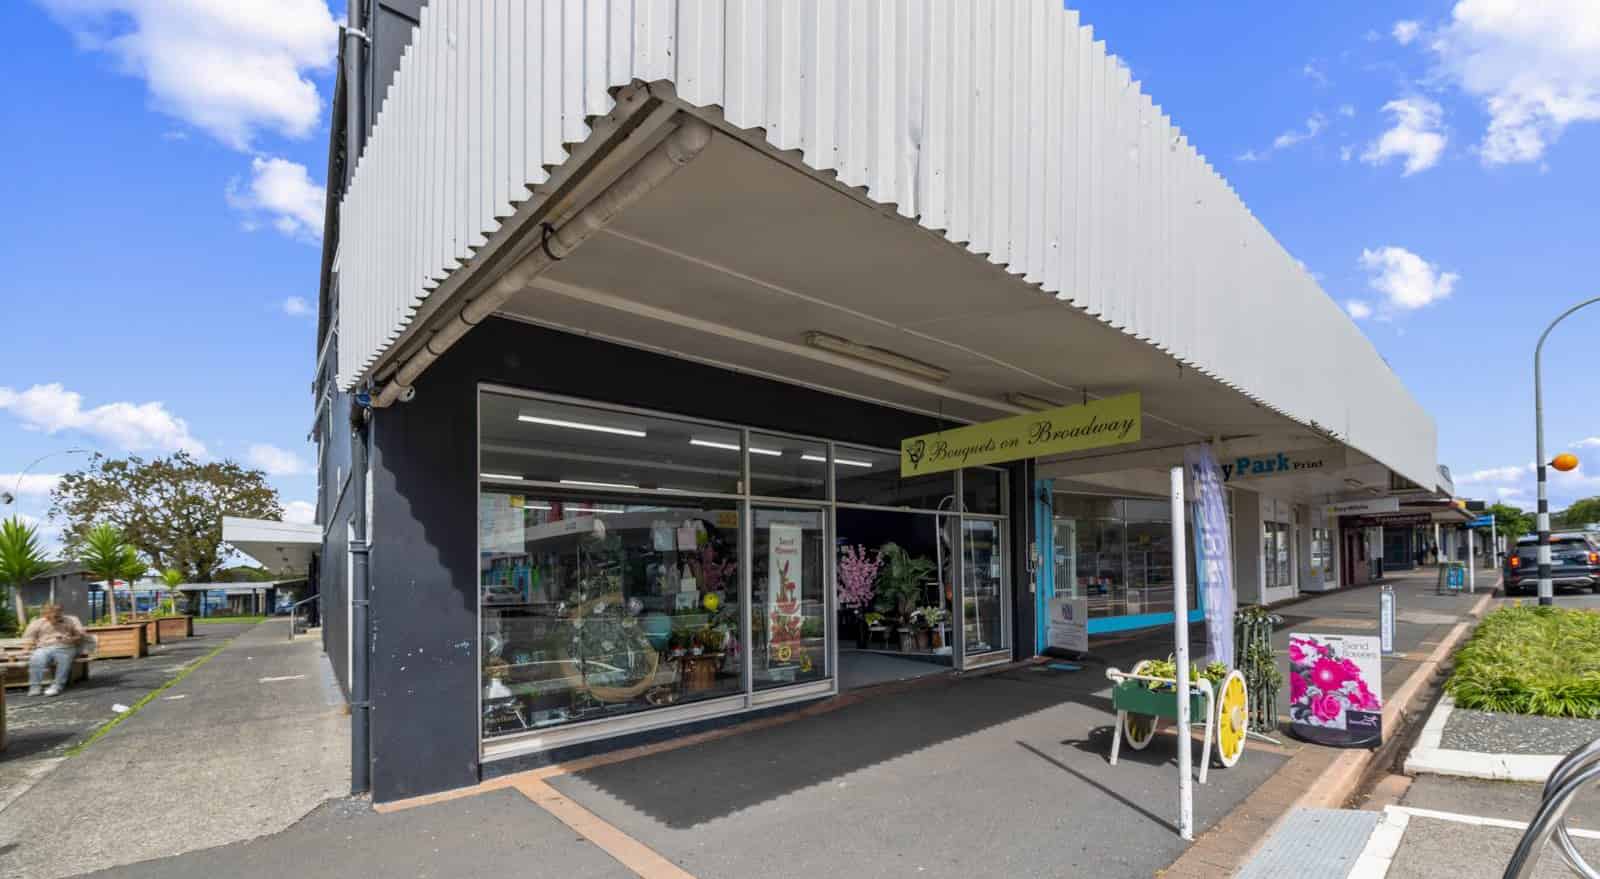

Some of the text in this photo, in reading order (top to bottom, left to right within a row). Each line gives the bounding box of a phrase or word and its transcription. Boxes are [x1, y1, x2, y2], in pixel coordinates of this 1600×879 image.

[929, 416, 1136, 463] Bouquets on Broadway
[1293, 459, 1323, 470] Print
